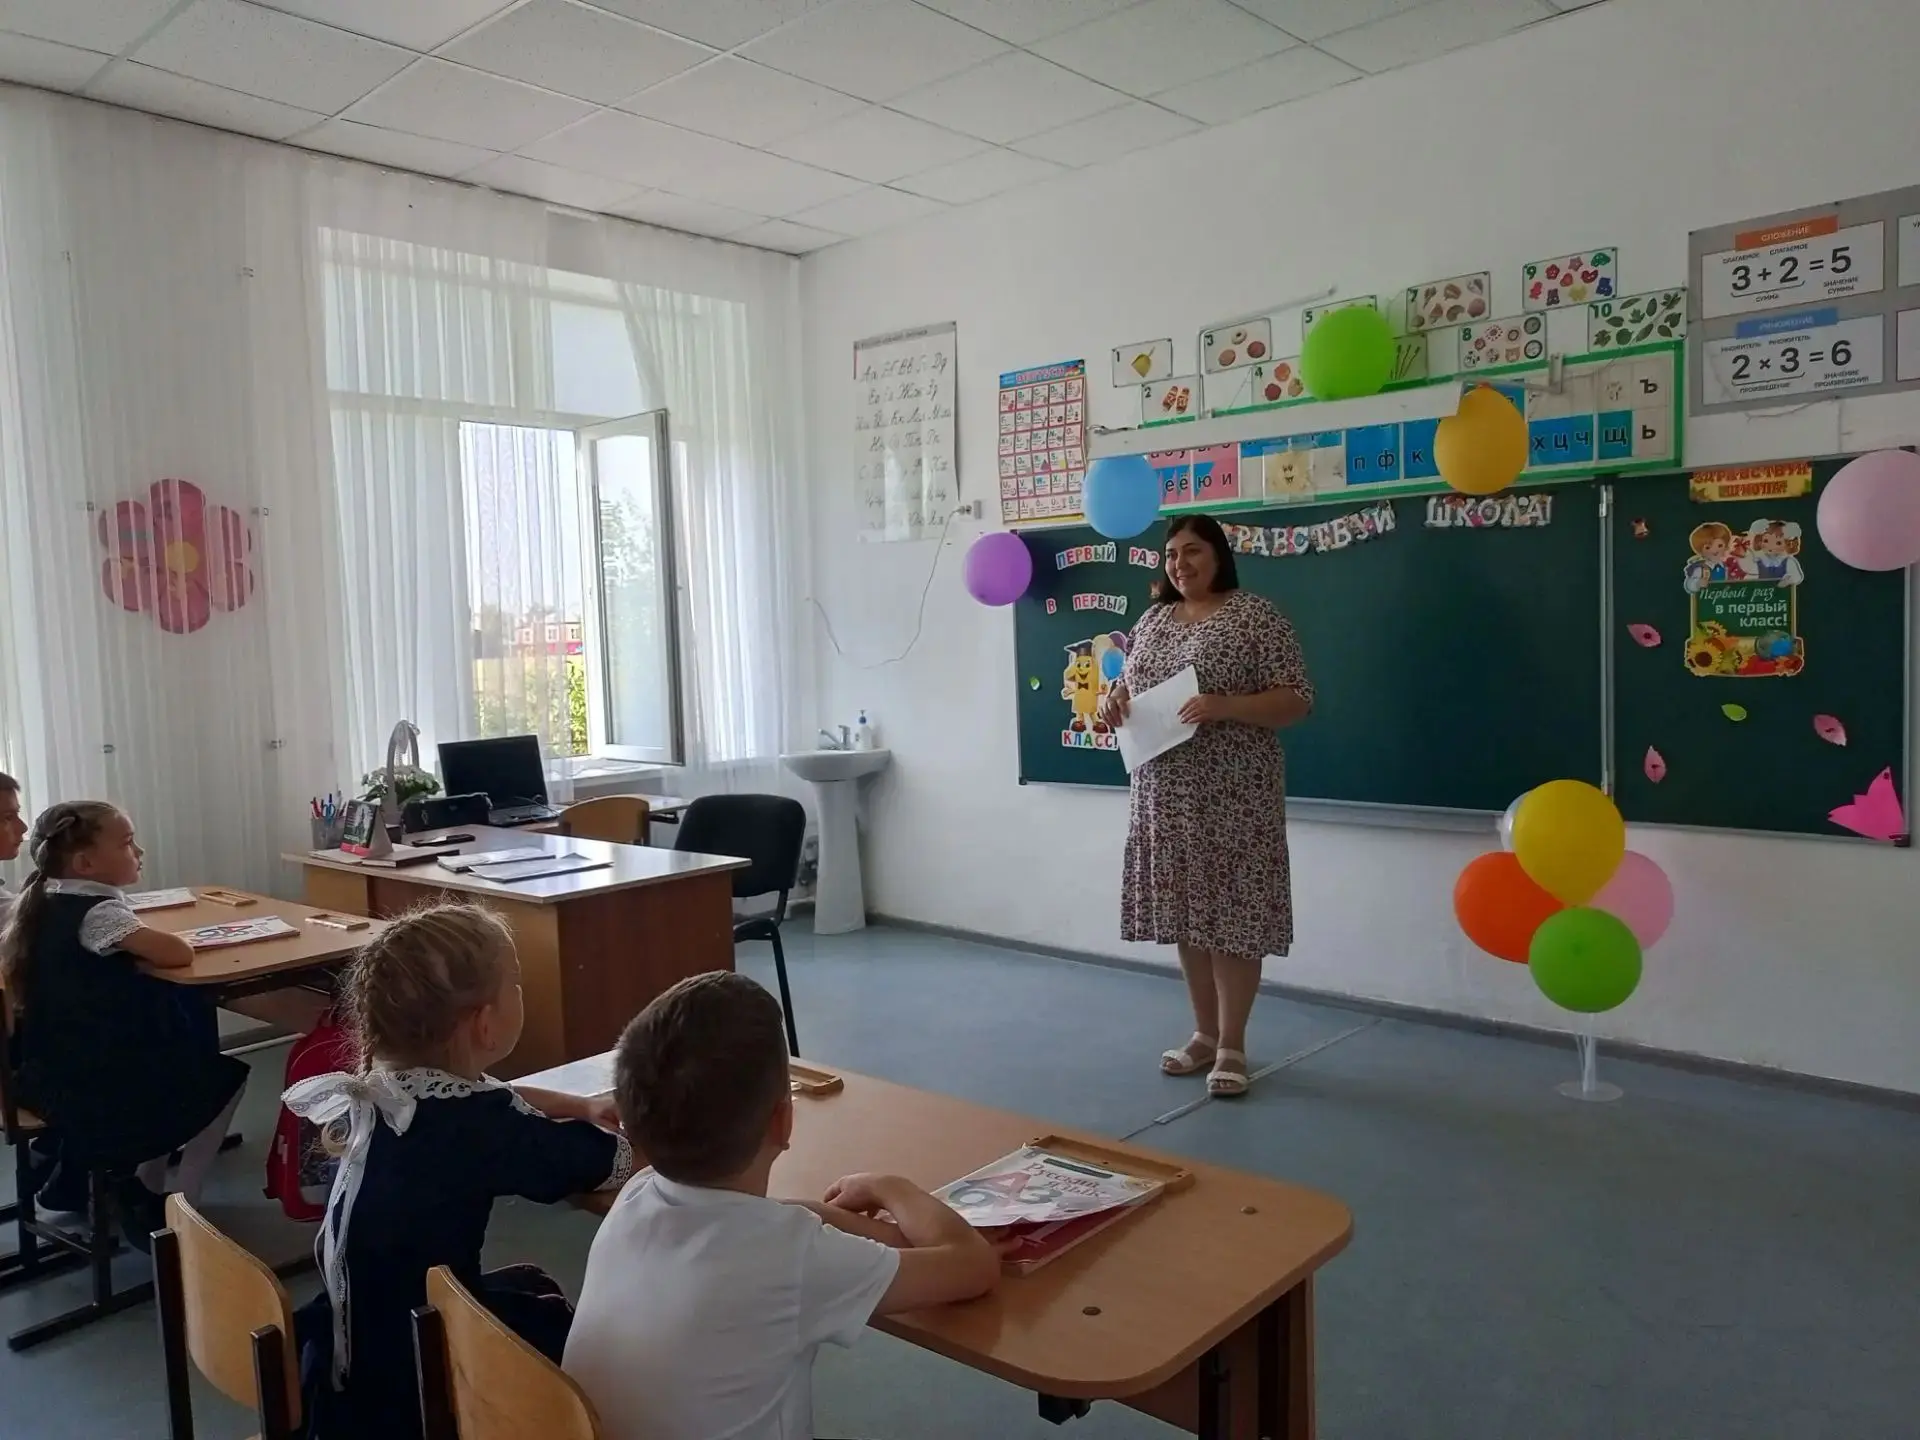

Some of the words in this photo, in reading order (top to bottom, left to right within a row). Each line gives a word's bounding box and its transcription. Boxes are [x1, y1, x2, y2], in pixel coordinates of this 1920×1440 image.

[1761, 225, 1810, 242] СЛОЖЕНИЕ
[1526, 265, 1537, 280] 9
[1732, 265, 1751, 291] 3
[1780, 256, 1798, 283] 2
[1831, 246, 1851, 274] 5
[1409, 289, 1419, 302] 7
[1305, 311, 1313, 323] 5
[1593, 303, 1612, 318] 10
[1206, 334, 1214, 346] 3
[1462, 328, 1472, 341] 8
[1732, 354, 1750, 380] 2
[1780, 347, 1800, 373] 3
[1831, 340, 1852, 367] 6
[1254, 367, 1263, 378] 4
[1144, 386, 1151, 398] 2
[1165, 479, 1175, 492] е
[1179, 473, 1188, 490] ё
[1198, 475, 1212, 488] ю
[1222, 473, 1232, 486] и
[1354, 456, 1365, 469] п
[1378, 450, 1394, 473] ф
[1554, 434, 1568, 450] ц
[1576, 431, 1588, 444] ч
[1222, 500, 1396, 557] РАВСТВУЙ
[1057, 542, 1116, 569] ПЕРВЫЙ
[1130, 547, 1160, 567] РАЗ
[1700, 586, 1749, 604] Первый
[1749, 588, 1775, 603] раз
[1046, 599, 1056, 614] В
[1073, 594, 1127, 614] ПЕРВЫЙ
[1715, 604, 1724, 614] в
[1728, 600, 1787, 616] первый
[1740, 614, 1787, 627] класс!
[1063, 731, 1118, 749] КЛАСС!
